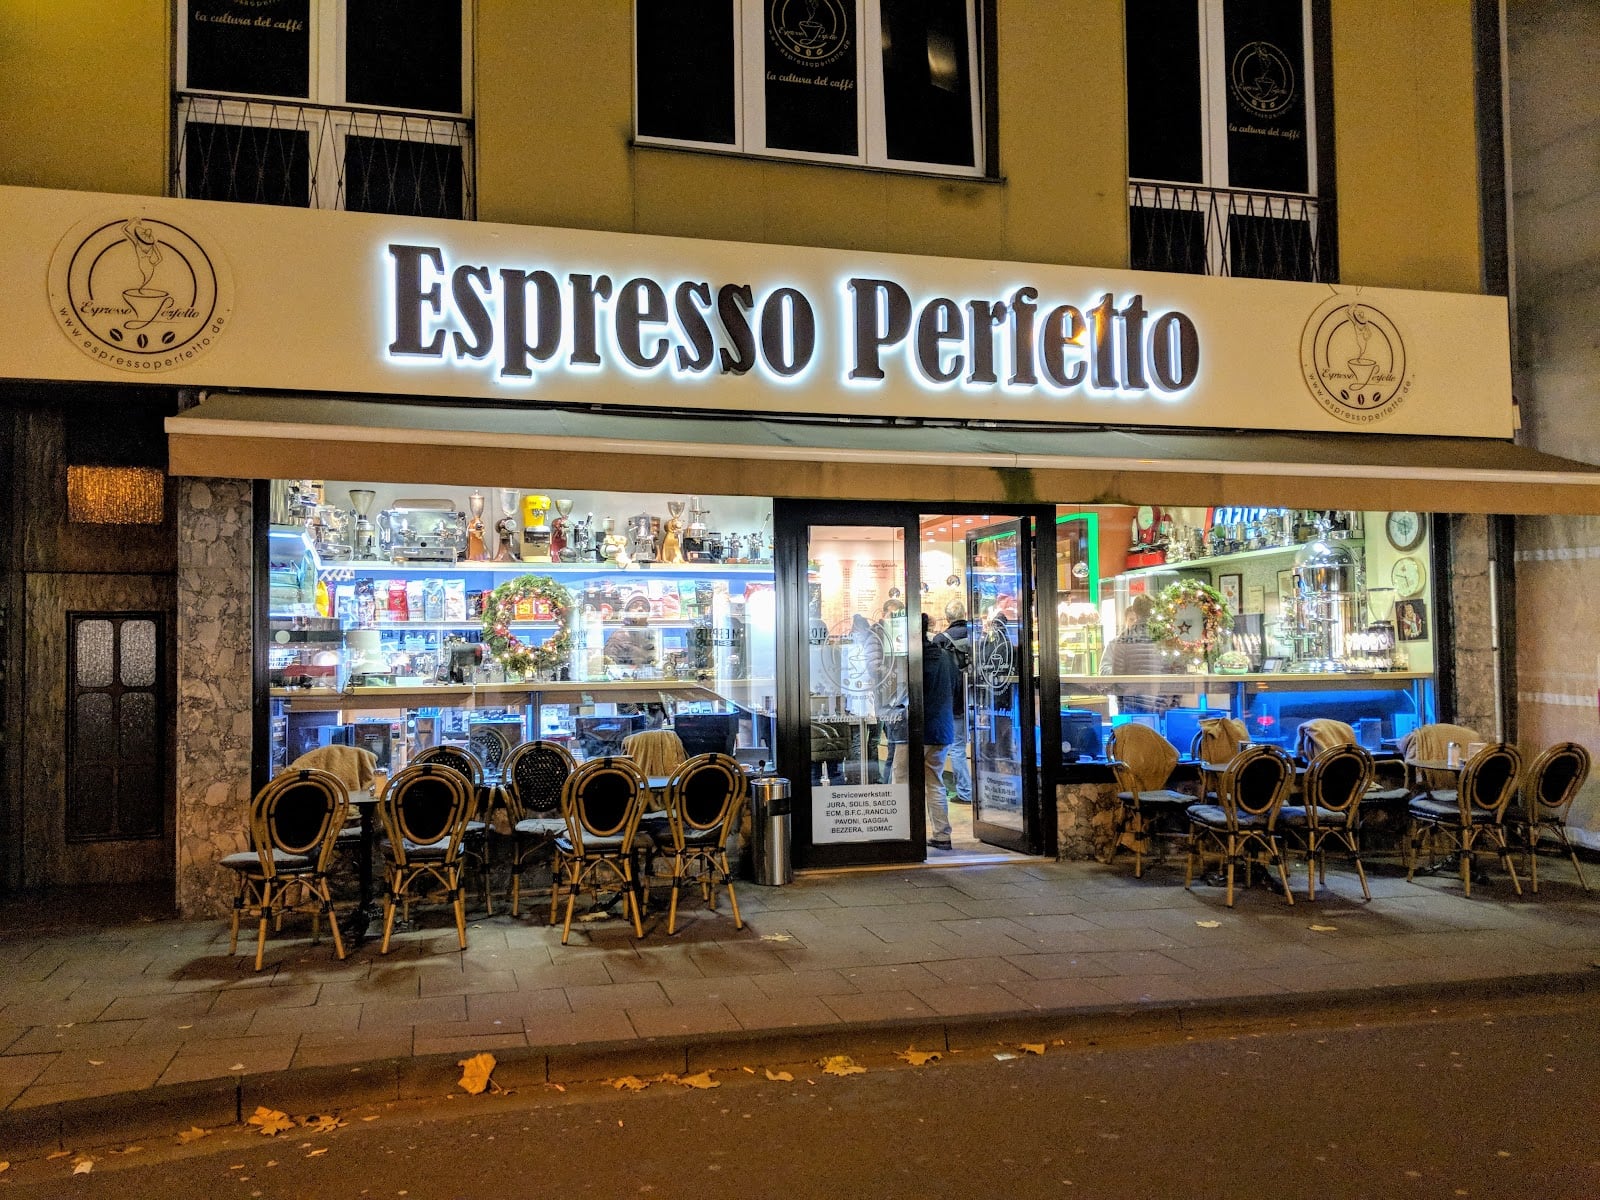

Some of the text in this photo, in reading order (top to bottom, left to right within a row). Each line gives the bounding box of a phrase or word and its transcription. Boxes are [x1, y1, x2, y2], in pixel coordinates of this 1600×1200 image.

[210, 11, 252, 27] cultura
[253, 16, 272, 28] del
[813, 76, 829, 87] del
[387, 243, 1200, 392] Espresso Perfetto
[59, 306, 225, 371] www.espressoperfetto.de
[873, 799, 897, 807] SAECO
